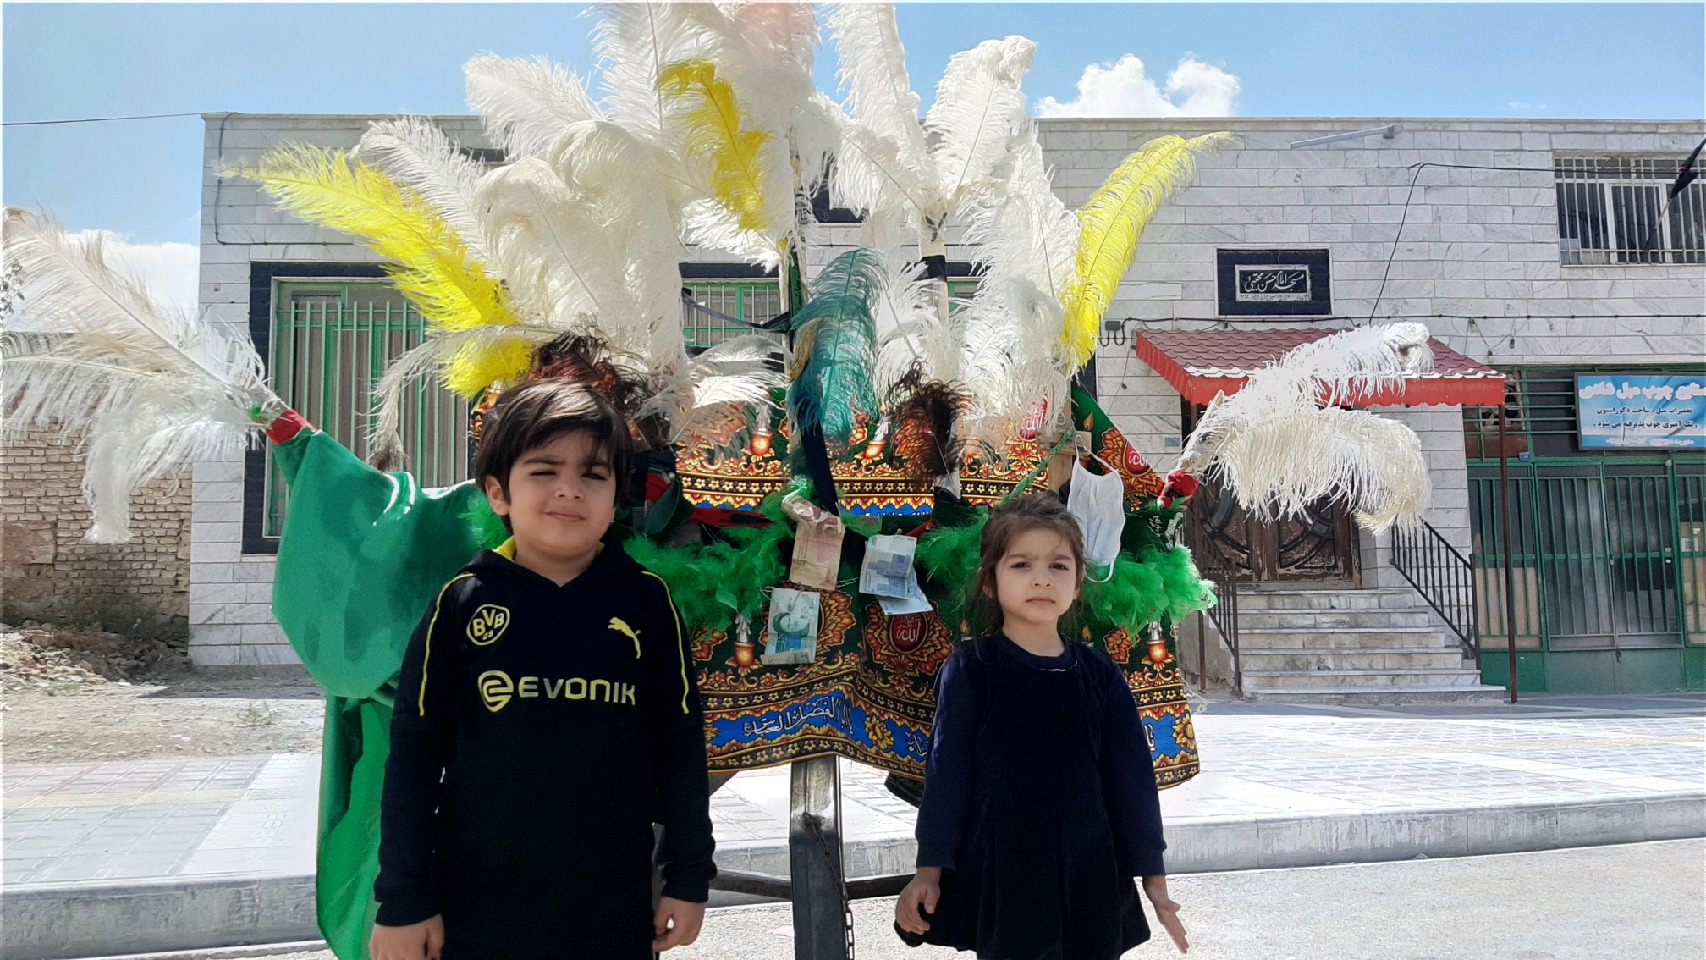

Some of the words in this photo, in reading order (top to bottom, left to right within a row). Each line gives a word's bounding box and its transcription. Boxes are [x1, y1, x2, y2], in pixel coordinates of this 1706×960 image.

[1256, 272, 1276, 292] حسن
[1272, 271, 1305, 292] مسجد
[1596, 406, 1631, 415] دکوراسیون
[472, 608, 505, 637] BVB
[518, 675, 636, 706] EVONIK
